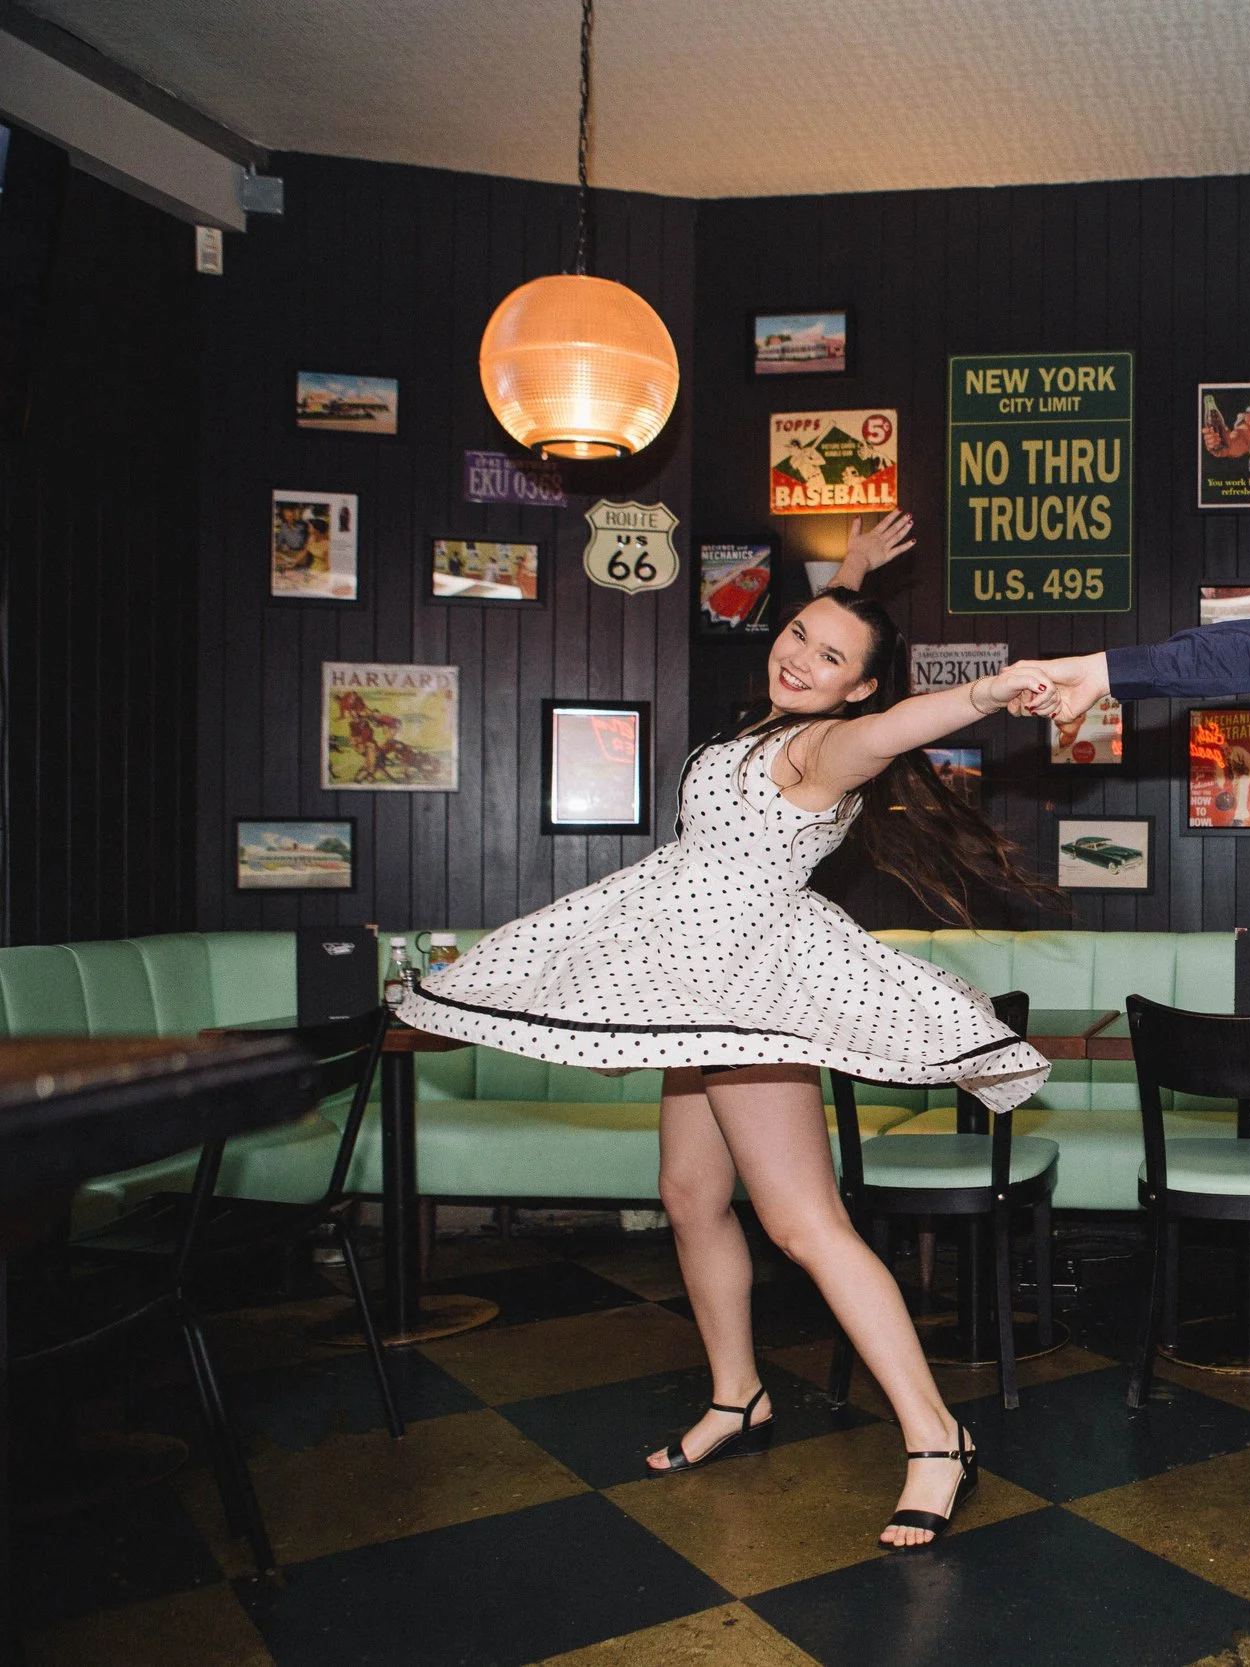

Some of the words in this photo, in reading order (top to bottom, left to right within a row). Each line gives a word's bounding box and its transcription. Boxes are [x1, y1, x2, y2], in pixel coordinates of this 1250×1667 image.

[965, 368, 1029, 394] NEW
[1038, 366, 1116, 392] YORK
[999, 398, 1034, 413] CITY
[1039, 396, 1081, 412] LIMIT
[775, 419, 820, 432] TOPPS
[960, 440, 1009, 486] NO
[1022, 438, 1120, 485] THRU
[1207, 478, 1223, 487] You
[1225, 478, 1247, 486] work
[775, 482, 894, 507] BASEBALL
[606, 511, 659, 528] ROUTE
[969, 495, 1112, 542] TRUCKS
[616, 535, 648, 546] US
[701, 550, 754, 560] MECHANICS
[607, 549, 657, 582] 66
[974, 568, 1034, 600] U.S.
[1043, 568, 1104, 600] 495
[331, 671, 450, 688] HARVARD
[1191, 796, 1212, 805] HOW
[1196, 807, 1207, 816] TO
[1189, 818, 1213, 827] BOWL
